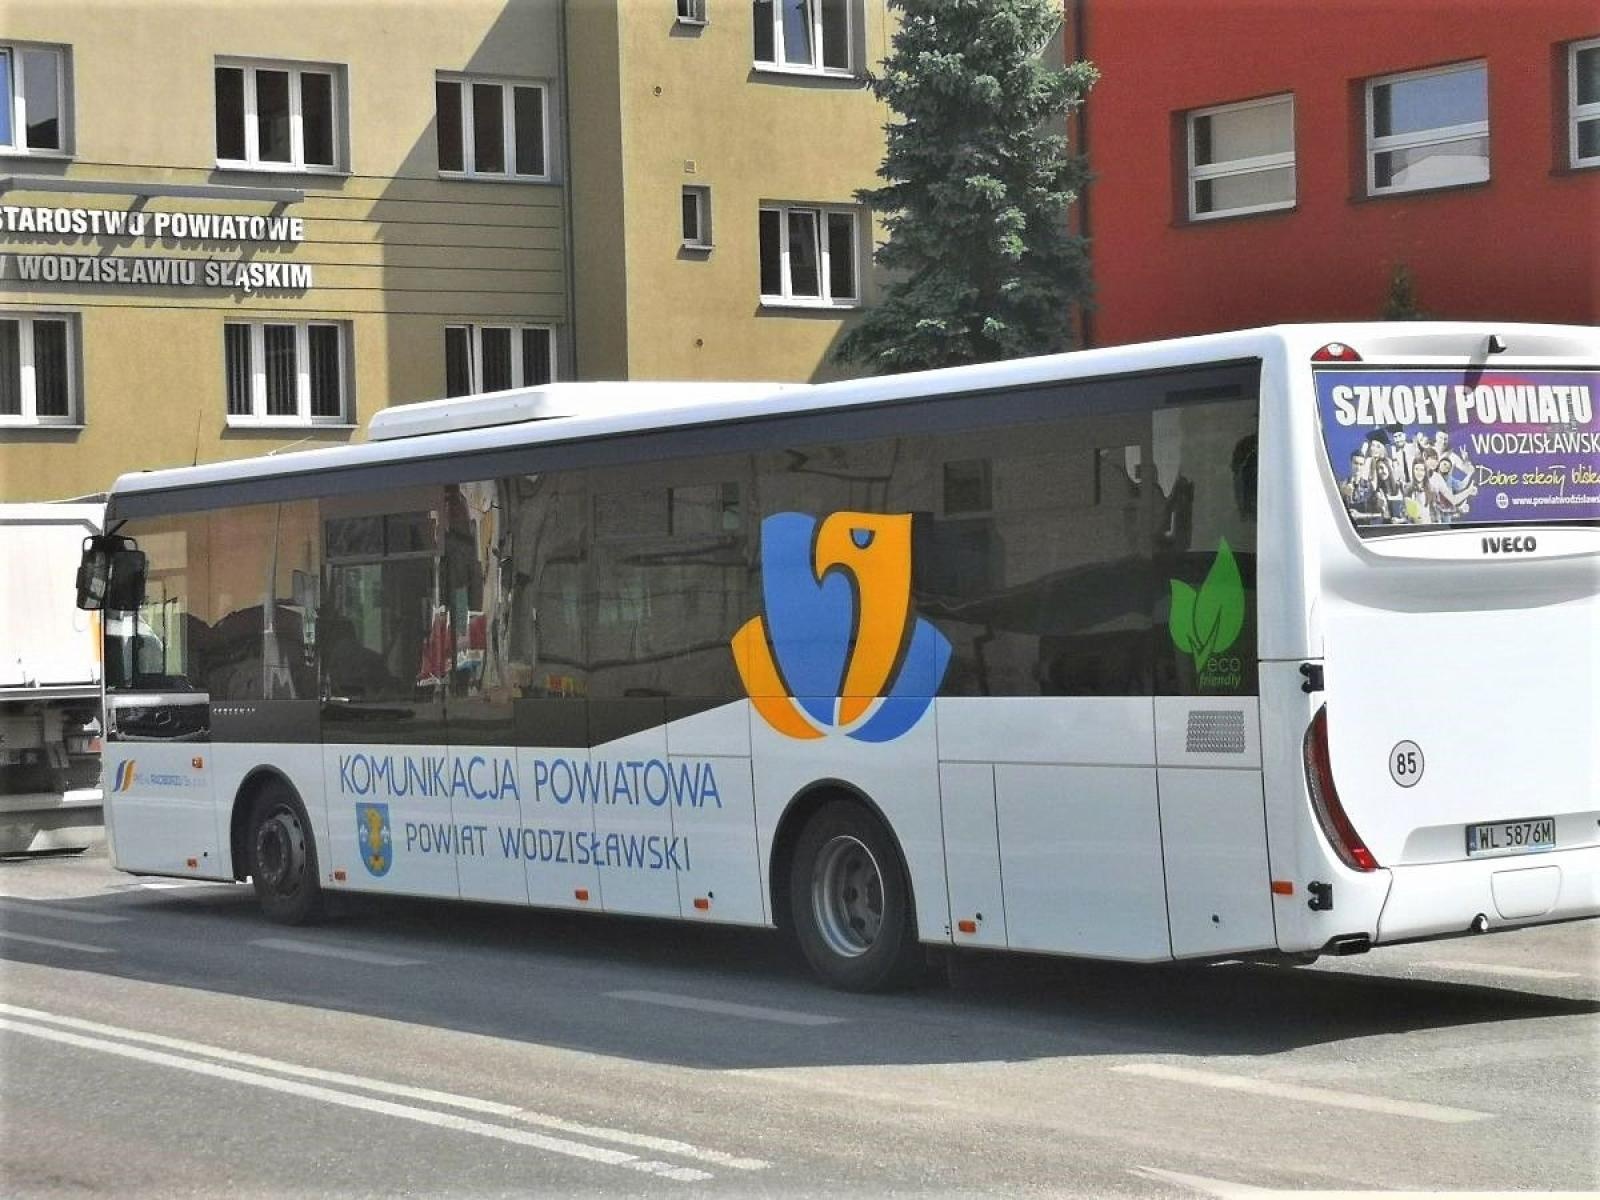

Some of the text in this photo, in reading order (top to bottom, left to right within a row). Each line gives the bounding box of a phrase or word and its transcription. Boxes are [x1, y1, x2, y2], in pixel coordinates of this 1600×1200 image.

[0, 206, 304, 241] TAROSTWO POWIATOWE
[18, 256, 196, 284] WODZISŁAWIU
[1332, 384, 1593, 426] SZKOŁY POWIATU
[1476, 464, 1518, 486] Dobre
[1481, 536, 1537, 553] IVECO
[1207, 657, 1241, 672] eco
[1198, 673, 1241, 689] friendly
[1396, 752, 1417, 775] 85
[339, 754, 722, 808] KOMUNIKACJA POWIATOWA
[405, 822, 691, 871] POWIAT WODZISŁAWSKI
[1479, 822, 1551, 849] WL 5876M
